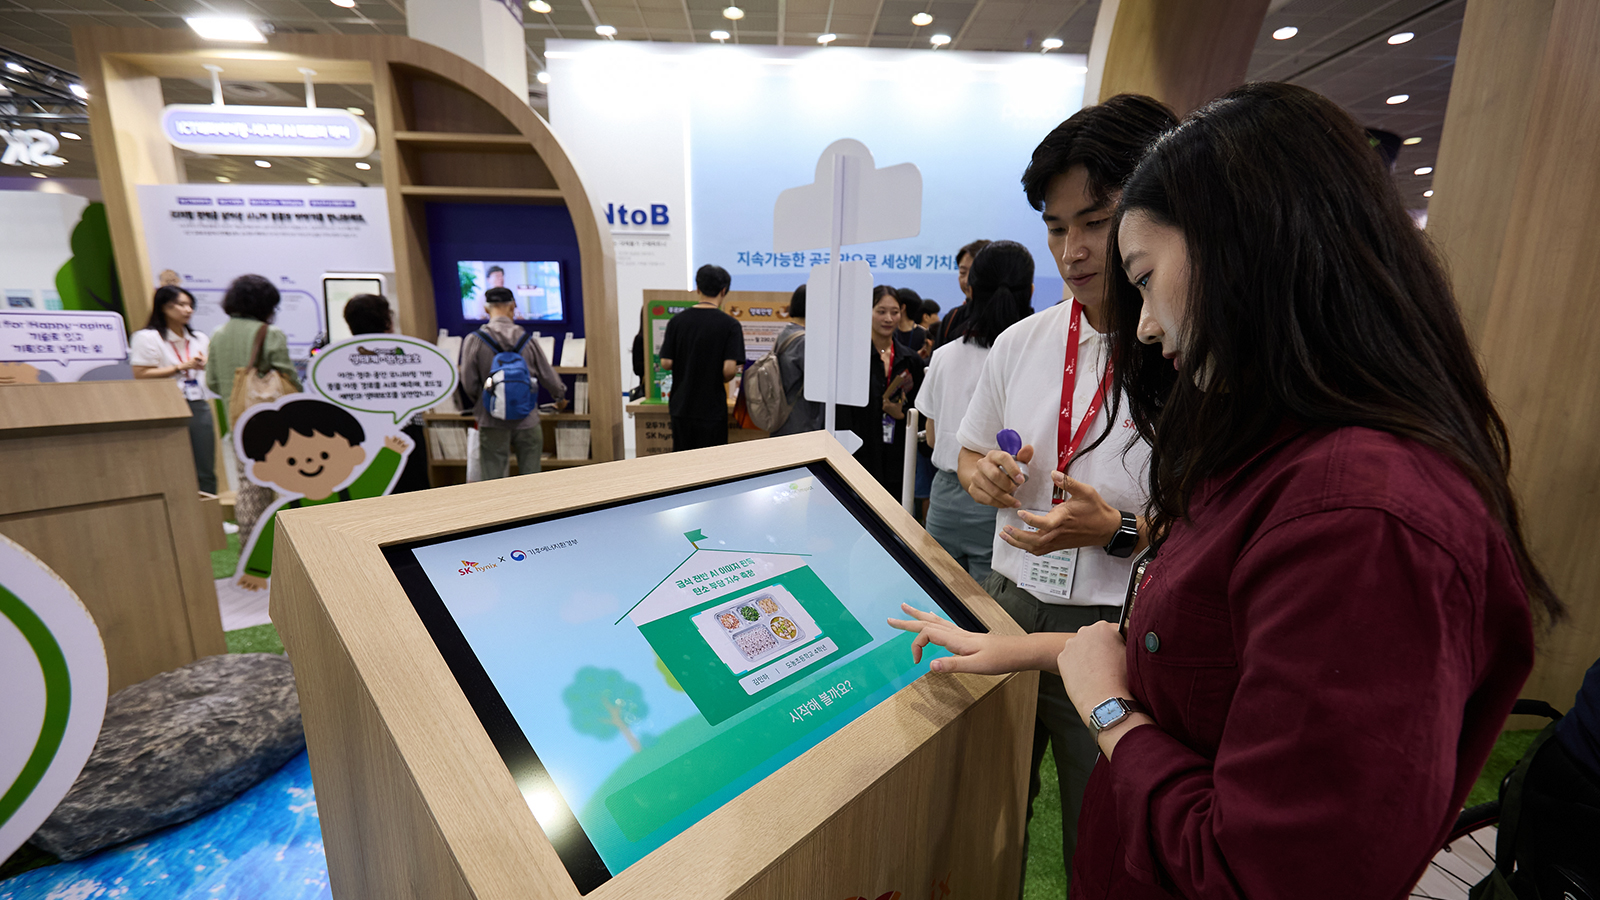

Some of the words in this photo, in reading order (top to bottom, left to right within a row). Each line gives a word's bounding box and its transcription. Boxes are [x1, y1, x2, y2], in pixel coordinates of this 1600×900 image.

[736, 251, 806, 267] 지속가능한
[881, 253, 922, 269] 세상에
[658, 432, 673, 441] hyn
[458, 567, 474, 576] SK
[475, 563, 498, 573] hynix
[675, 577, 694, 589] 급식
[709, 569, 719, 578] AI
[718, 562, 741, 574] 이미지
[692, 586, 711, 596] 탄소
[724, 575, 741, 584] 지수
[789, 697, 823, 723] 시작해
[818, 680, 854, 706] 볼까요?
